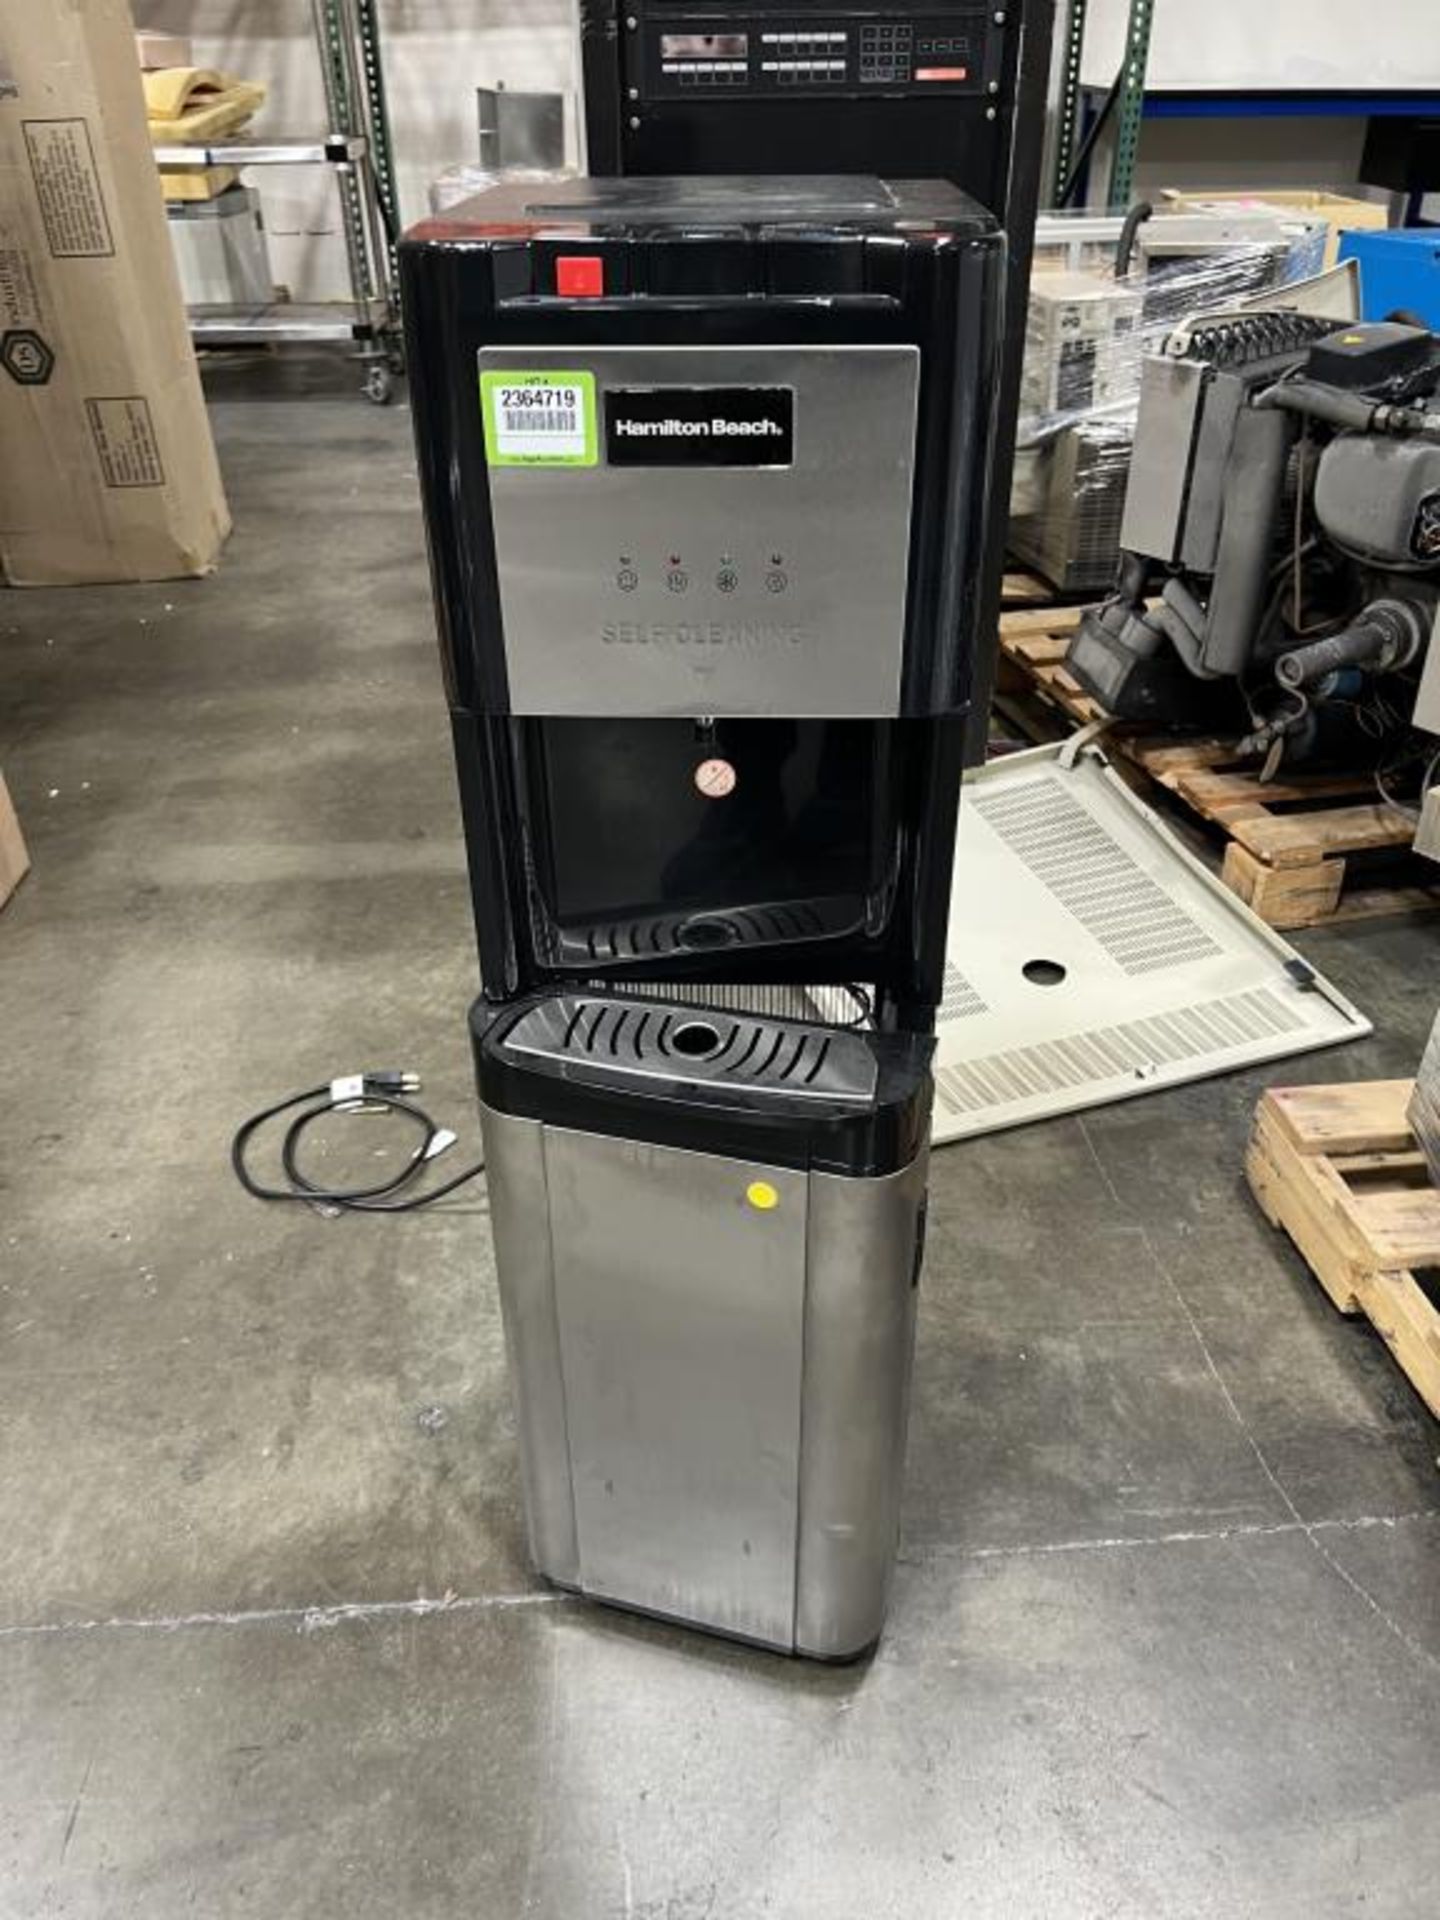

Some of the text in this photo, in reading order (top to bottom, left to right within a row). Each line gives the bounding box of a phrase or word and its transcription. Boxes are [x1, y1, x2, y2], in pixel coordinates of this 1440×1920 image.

[501, 389, 576, 408] 2364719
[615, 418, 709, 436] Hamilton
[602, 621, 670, 645] SELF
